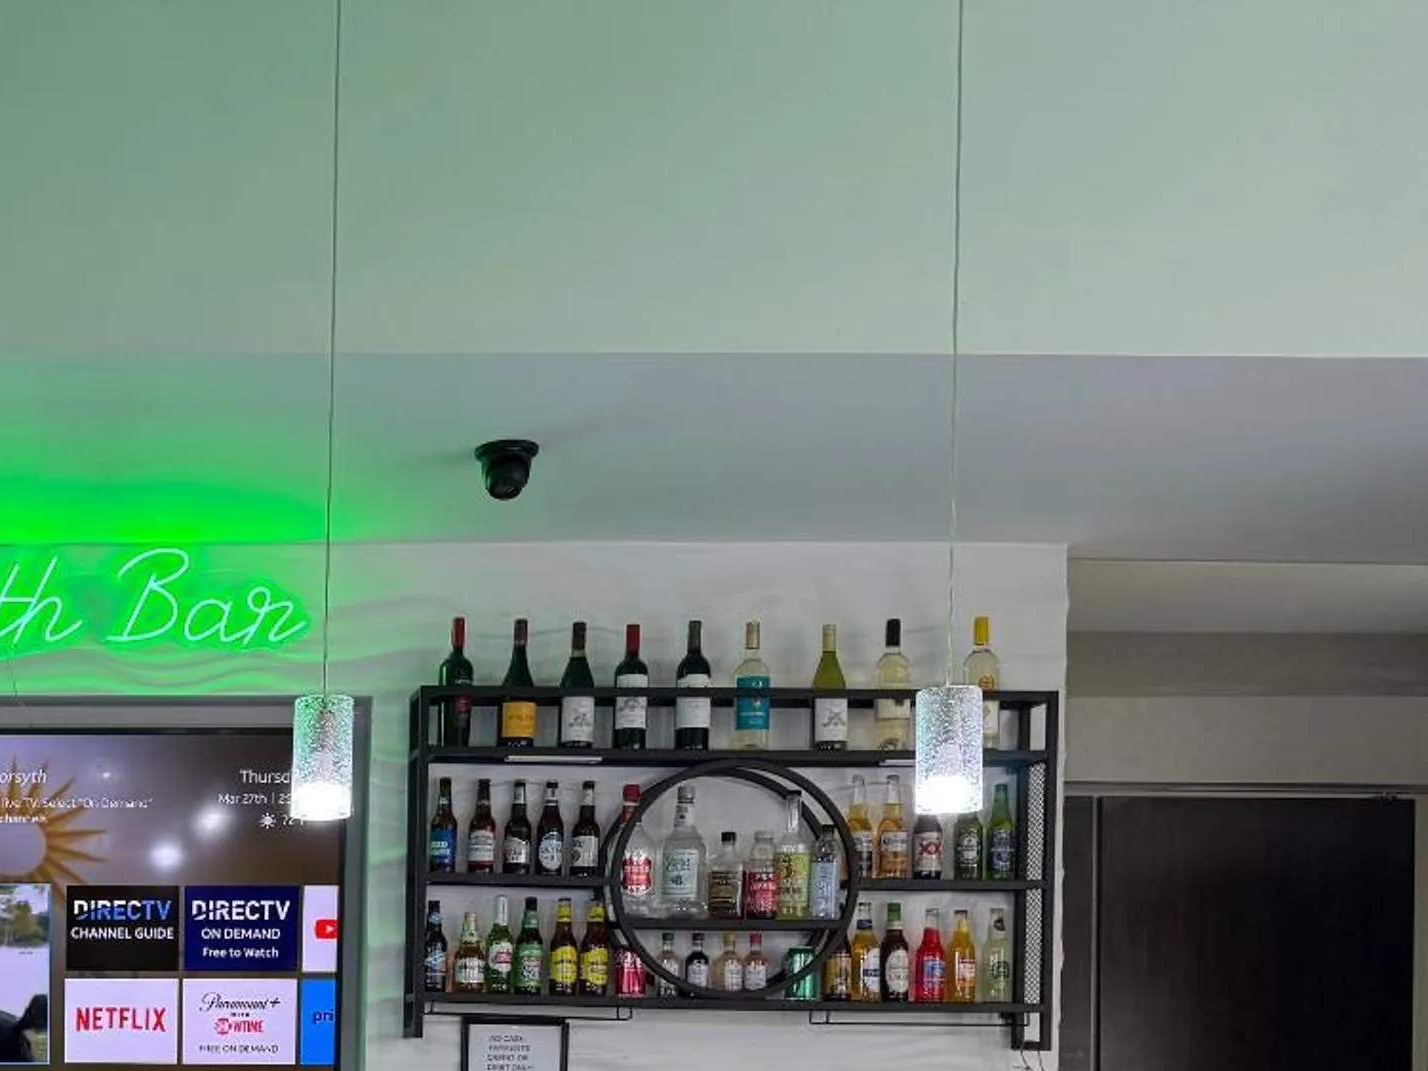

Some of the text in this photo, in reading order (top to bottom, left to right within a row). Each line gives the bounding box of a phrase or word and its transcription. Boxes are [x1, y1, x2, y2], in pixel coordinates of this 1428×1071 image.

[106, 547, 310, 644] Bar
[73, 900, 172, 920] DIRECTV
[192, 900, 291, 921] DIRECTV
[71, 927, 174, 940] CHANNEL GUIDE
[201, 928, 281, 940] ON DEMAND
[202, 947, 279, 958] Free to Watch
[76, 1007, 166, 1032] NETFLIX
